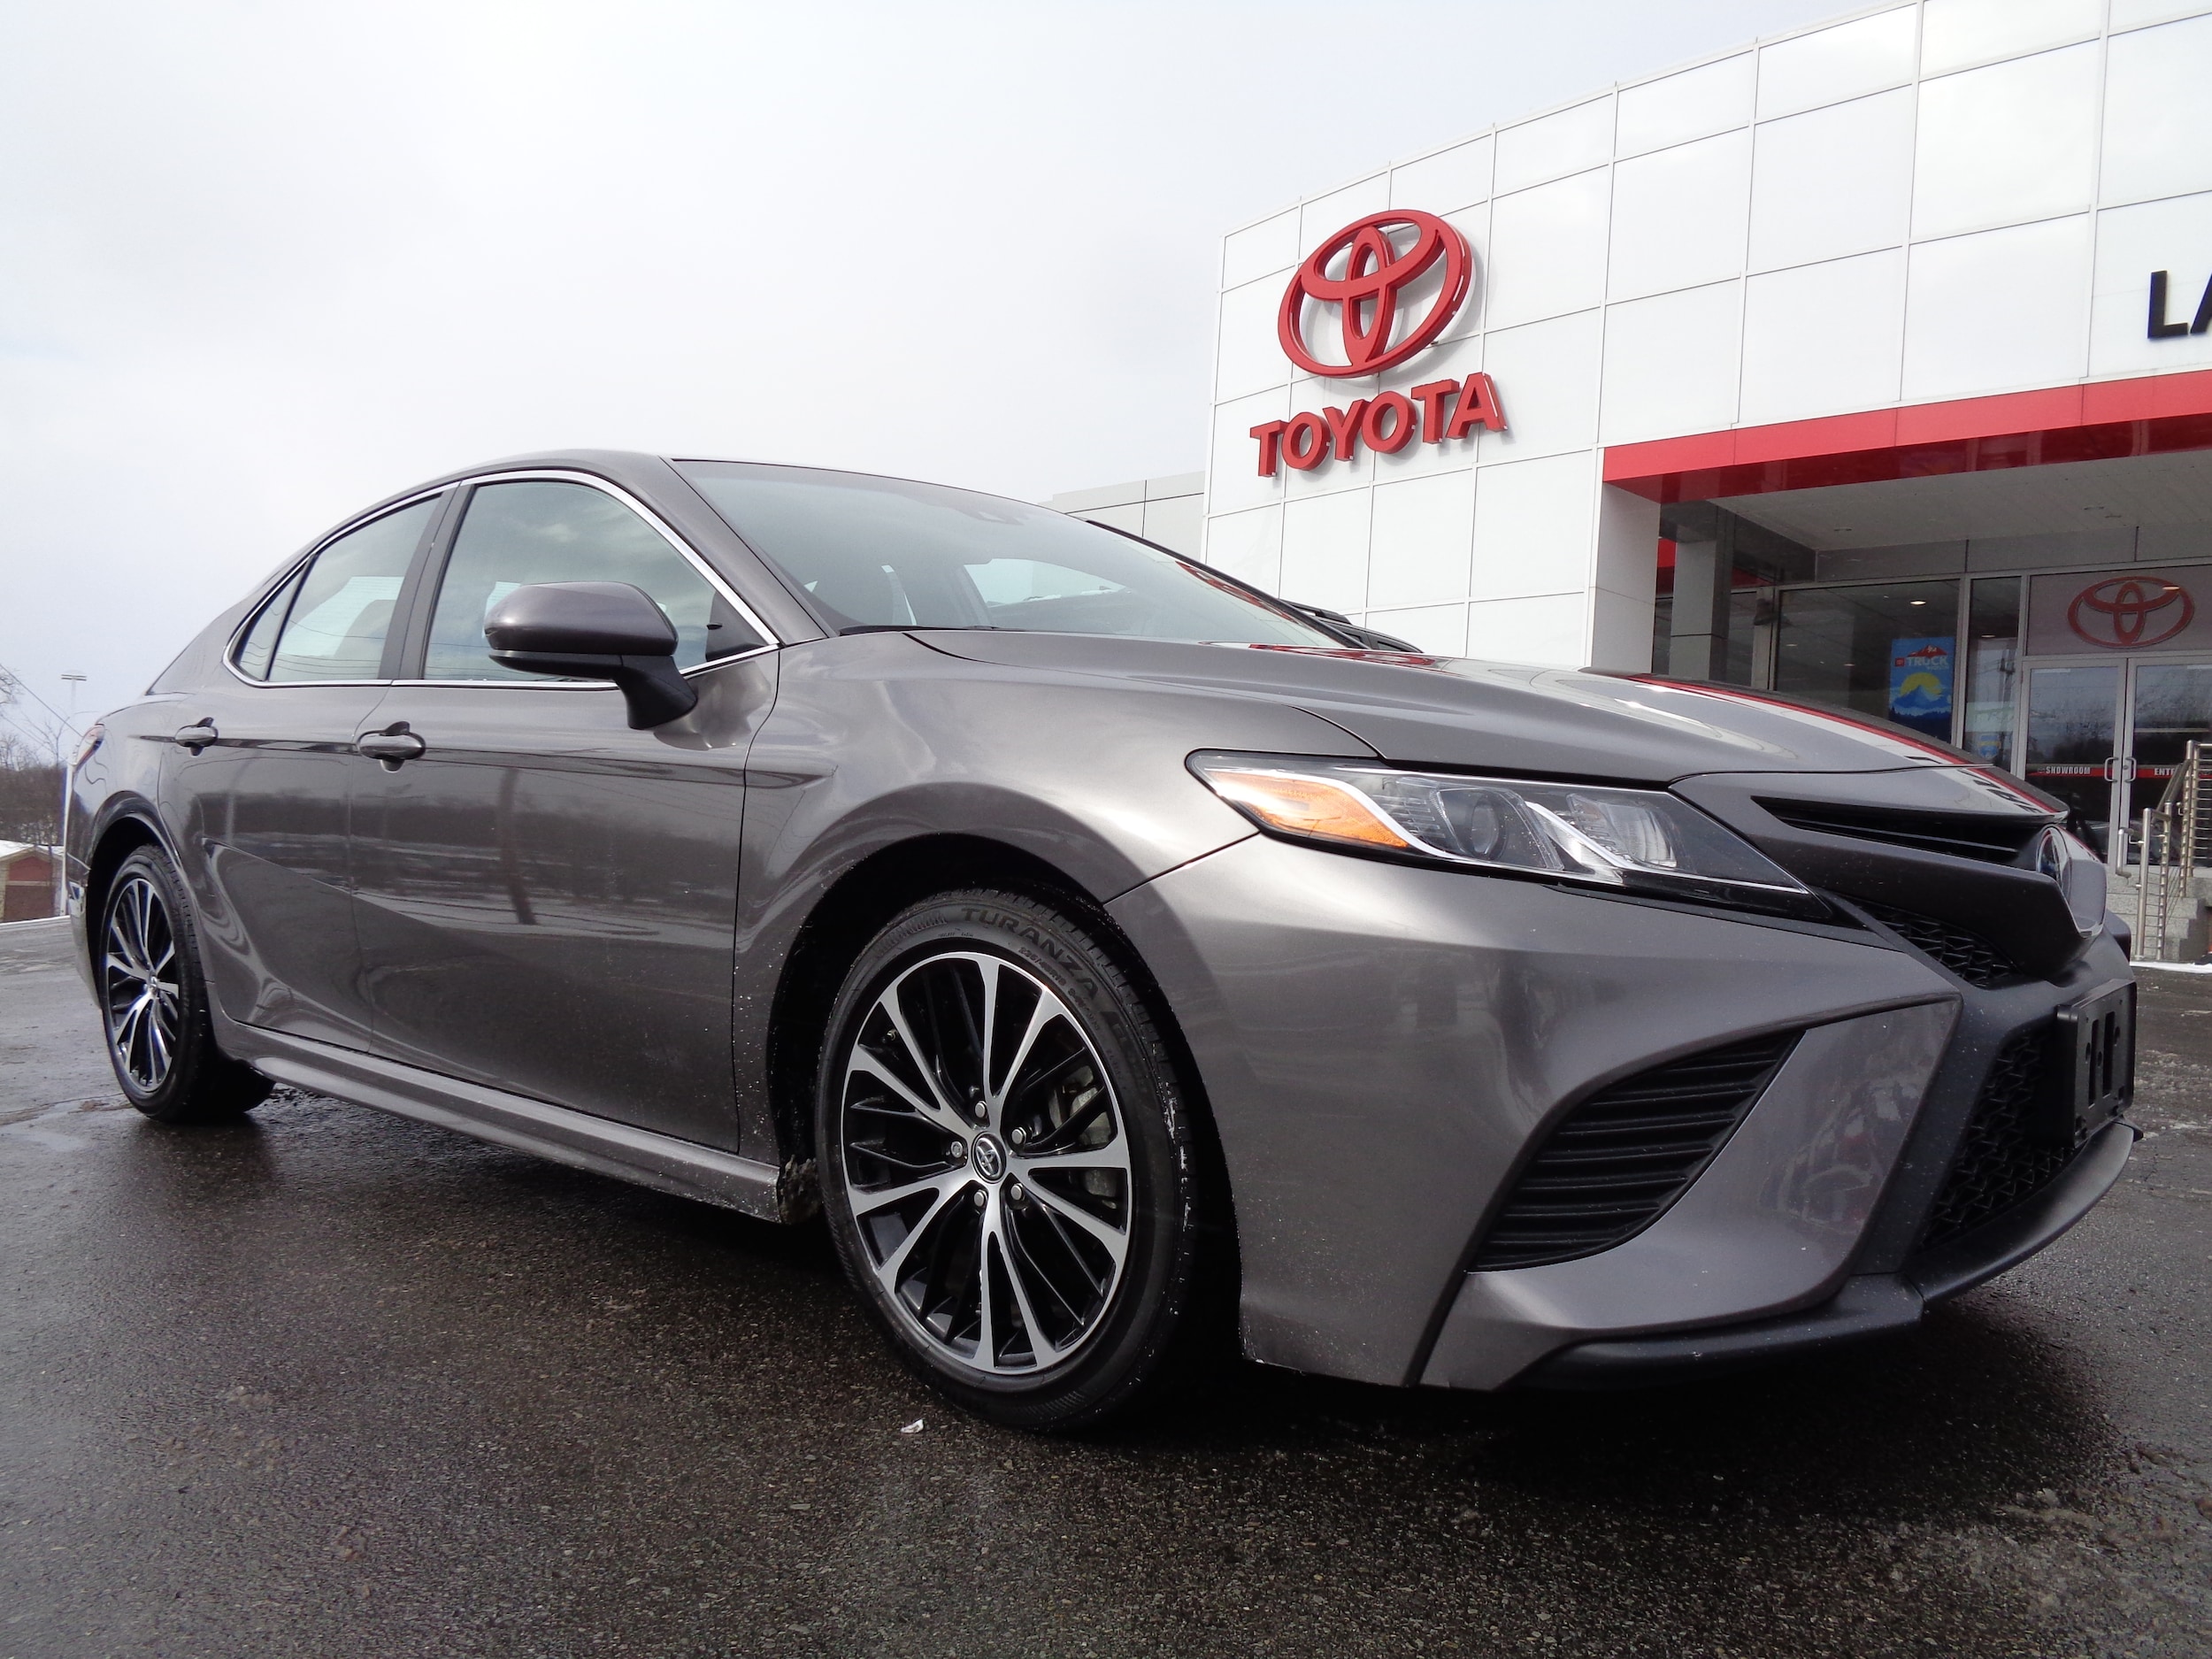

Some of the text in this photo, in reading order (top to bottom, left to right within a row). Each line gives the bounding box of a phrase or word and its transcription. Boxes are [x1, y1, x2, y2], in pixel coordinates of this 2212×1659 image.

[1249, 372, 1507, 478] TOYOTA
[1907, 656, 1949, 666] TRUCK
[2046, 766, 2091, 775] SHOWROOM
[961, 908, 1099, 1000] TURANZA
